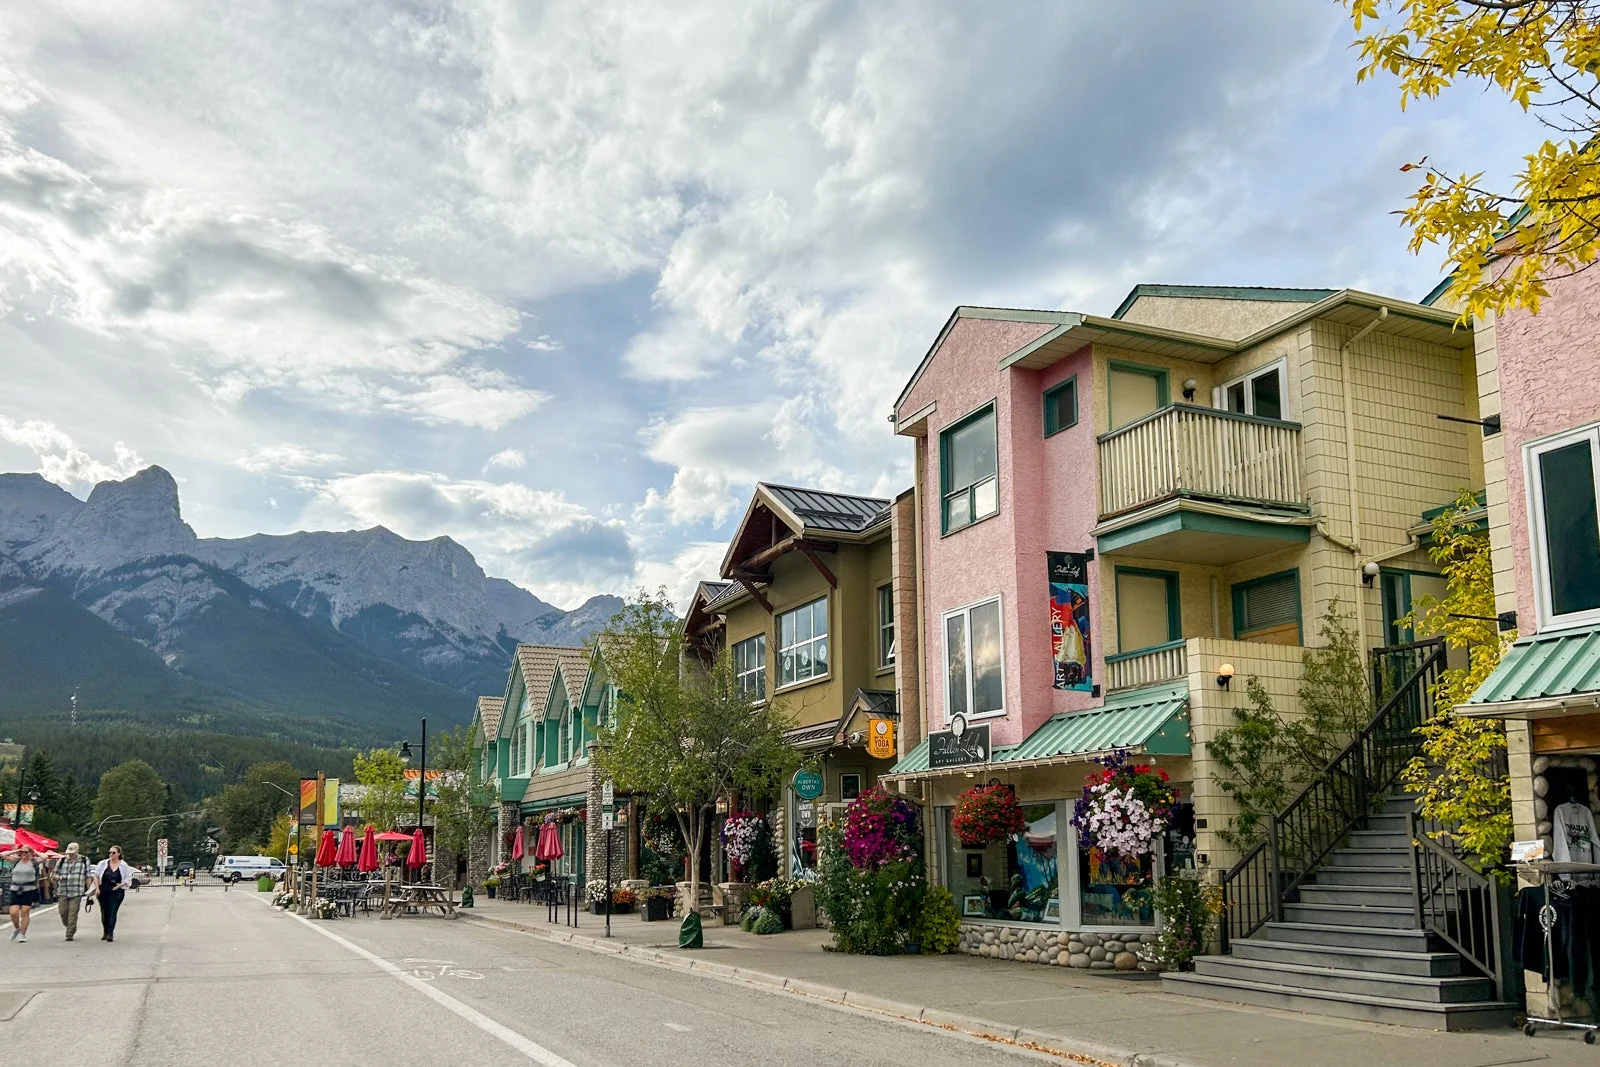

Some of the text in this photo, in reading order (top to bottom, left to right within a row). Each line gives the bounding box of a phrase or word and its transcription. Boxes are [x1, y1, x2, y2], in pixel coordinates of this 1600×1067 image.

[1051, 607, 1066, 690] ART GALLERY
[874, 739, 889, 748] YOGA
[934, 732, 980, 758] Fallen Leaf
